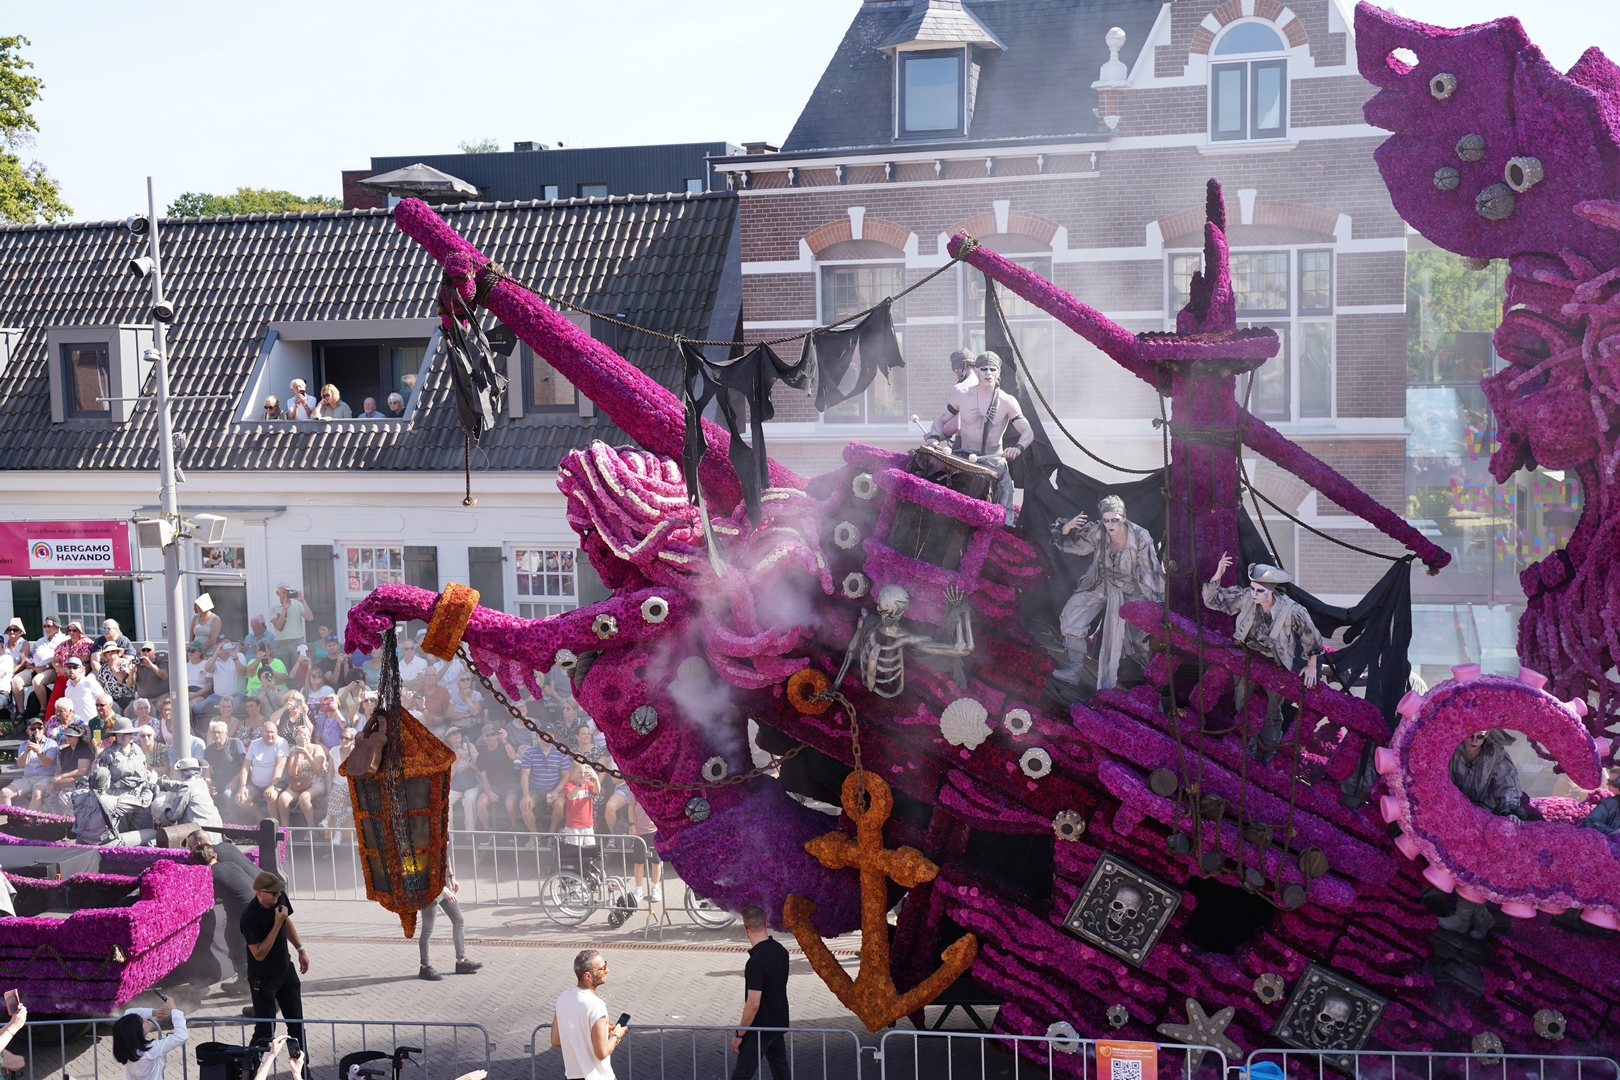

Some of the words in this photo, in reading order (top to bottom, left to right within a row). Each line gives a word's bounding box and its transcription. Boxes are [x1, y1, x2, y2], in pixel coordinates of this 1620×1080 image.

[1449, 478, 1516, 512] VAN
[56, 544, 110, 552] BERGAMO
[56, 553, 111, 561] HAVANDO
